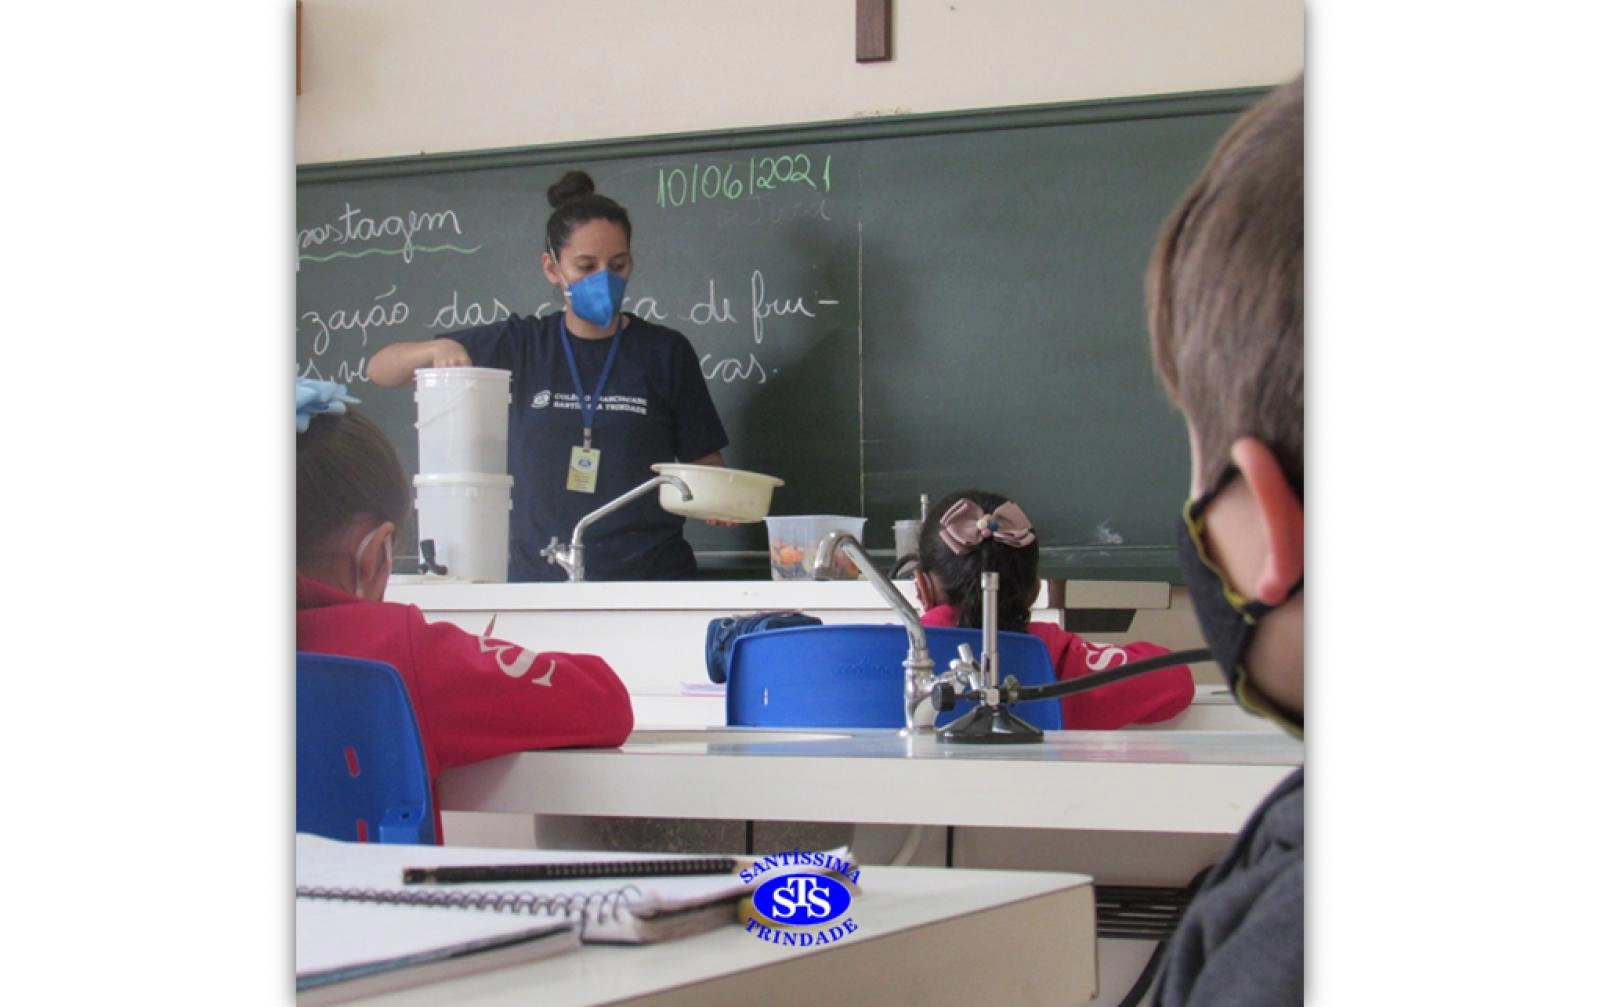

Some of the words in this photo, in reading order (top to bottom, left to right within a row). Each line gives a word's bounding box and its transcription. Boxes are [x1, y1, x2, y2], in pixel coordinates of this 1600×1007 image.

[658, 154, 832, 208] 10/06/2021
[423, 291, 510, 329] das
[678, 279, 738, 325] de
